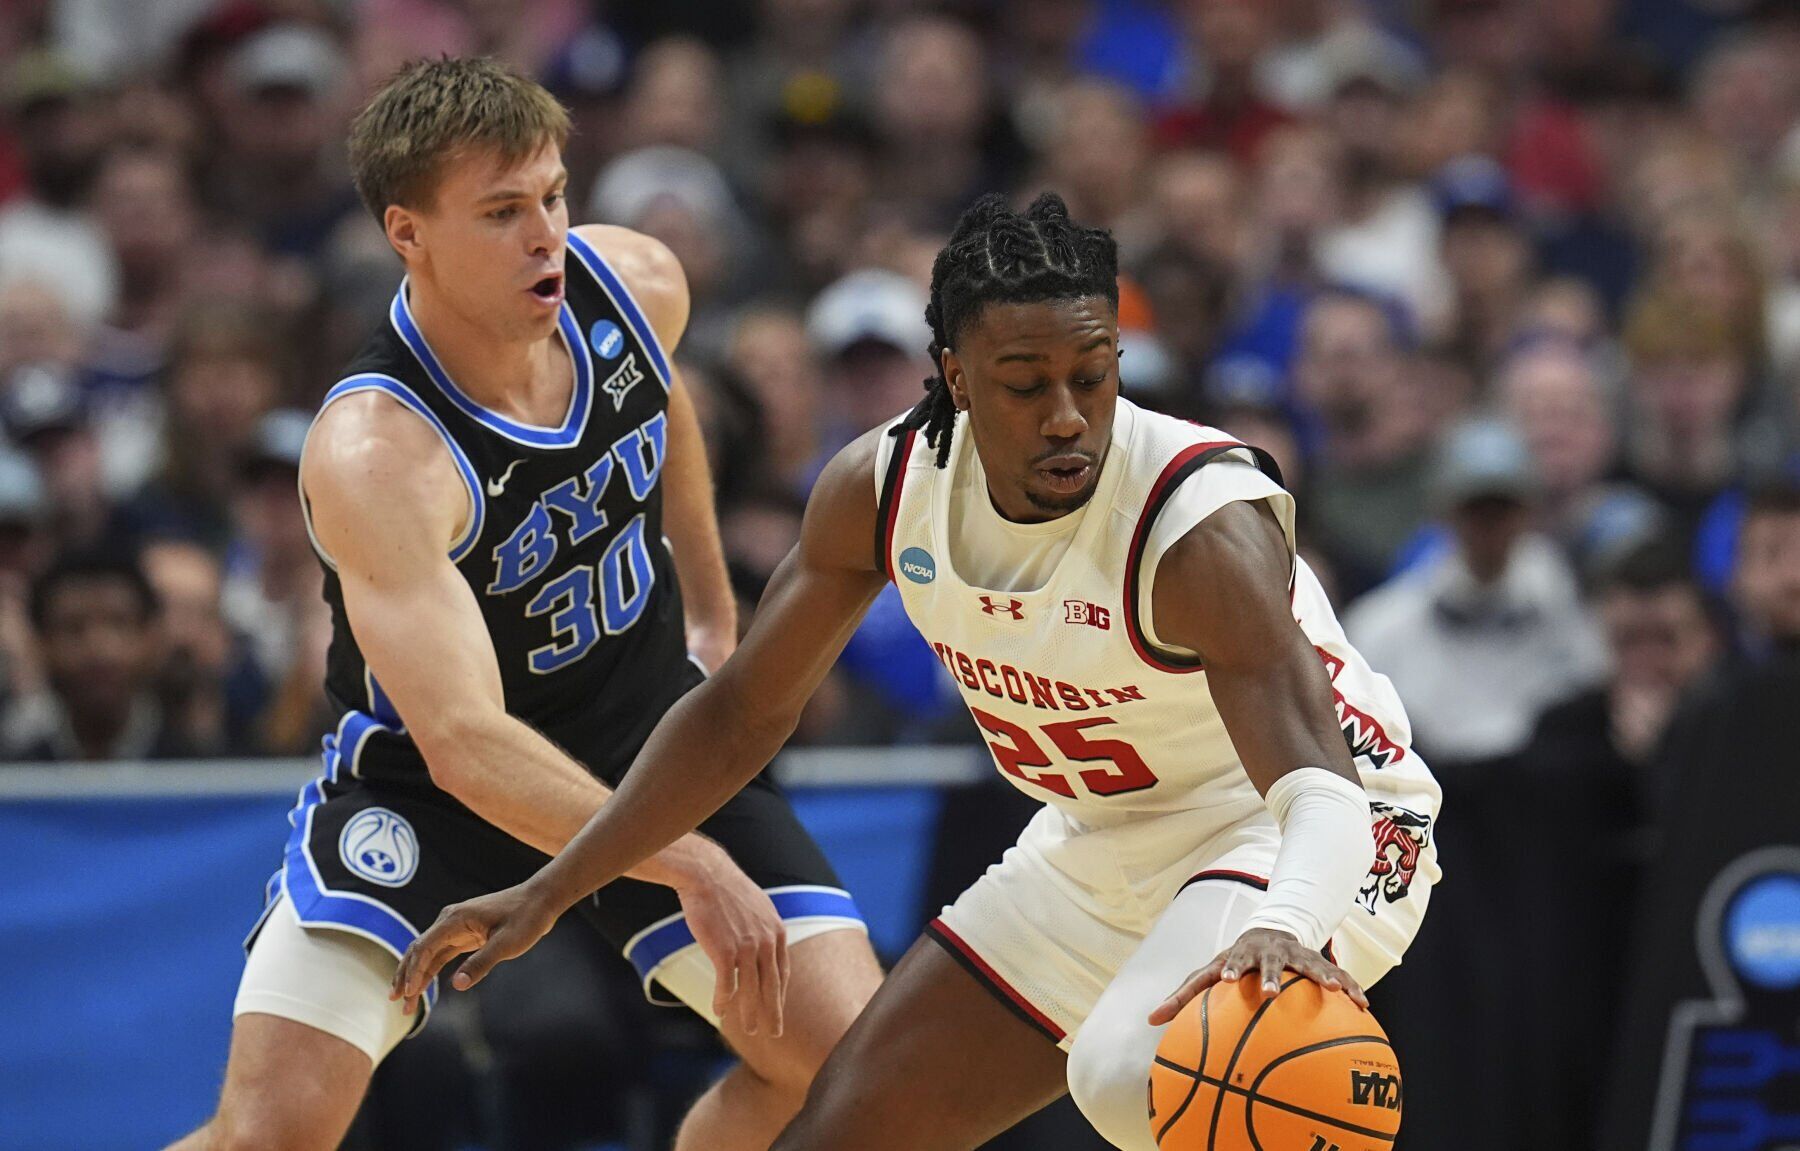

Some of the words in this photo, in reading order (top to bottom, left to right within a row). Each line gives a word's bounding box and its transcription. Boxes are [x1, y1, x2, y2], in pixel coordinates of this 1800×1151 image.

[486, 410, 667, 596] BYU
[525, 512, 655, 675] 30
[903, 561, 934, 580] NCAA
[970, 705, 1160, 800] 25
